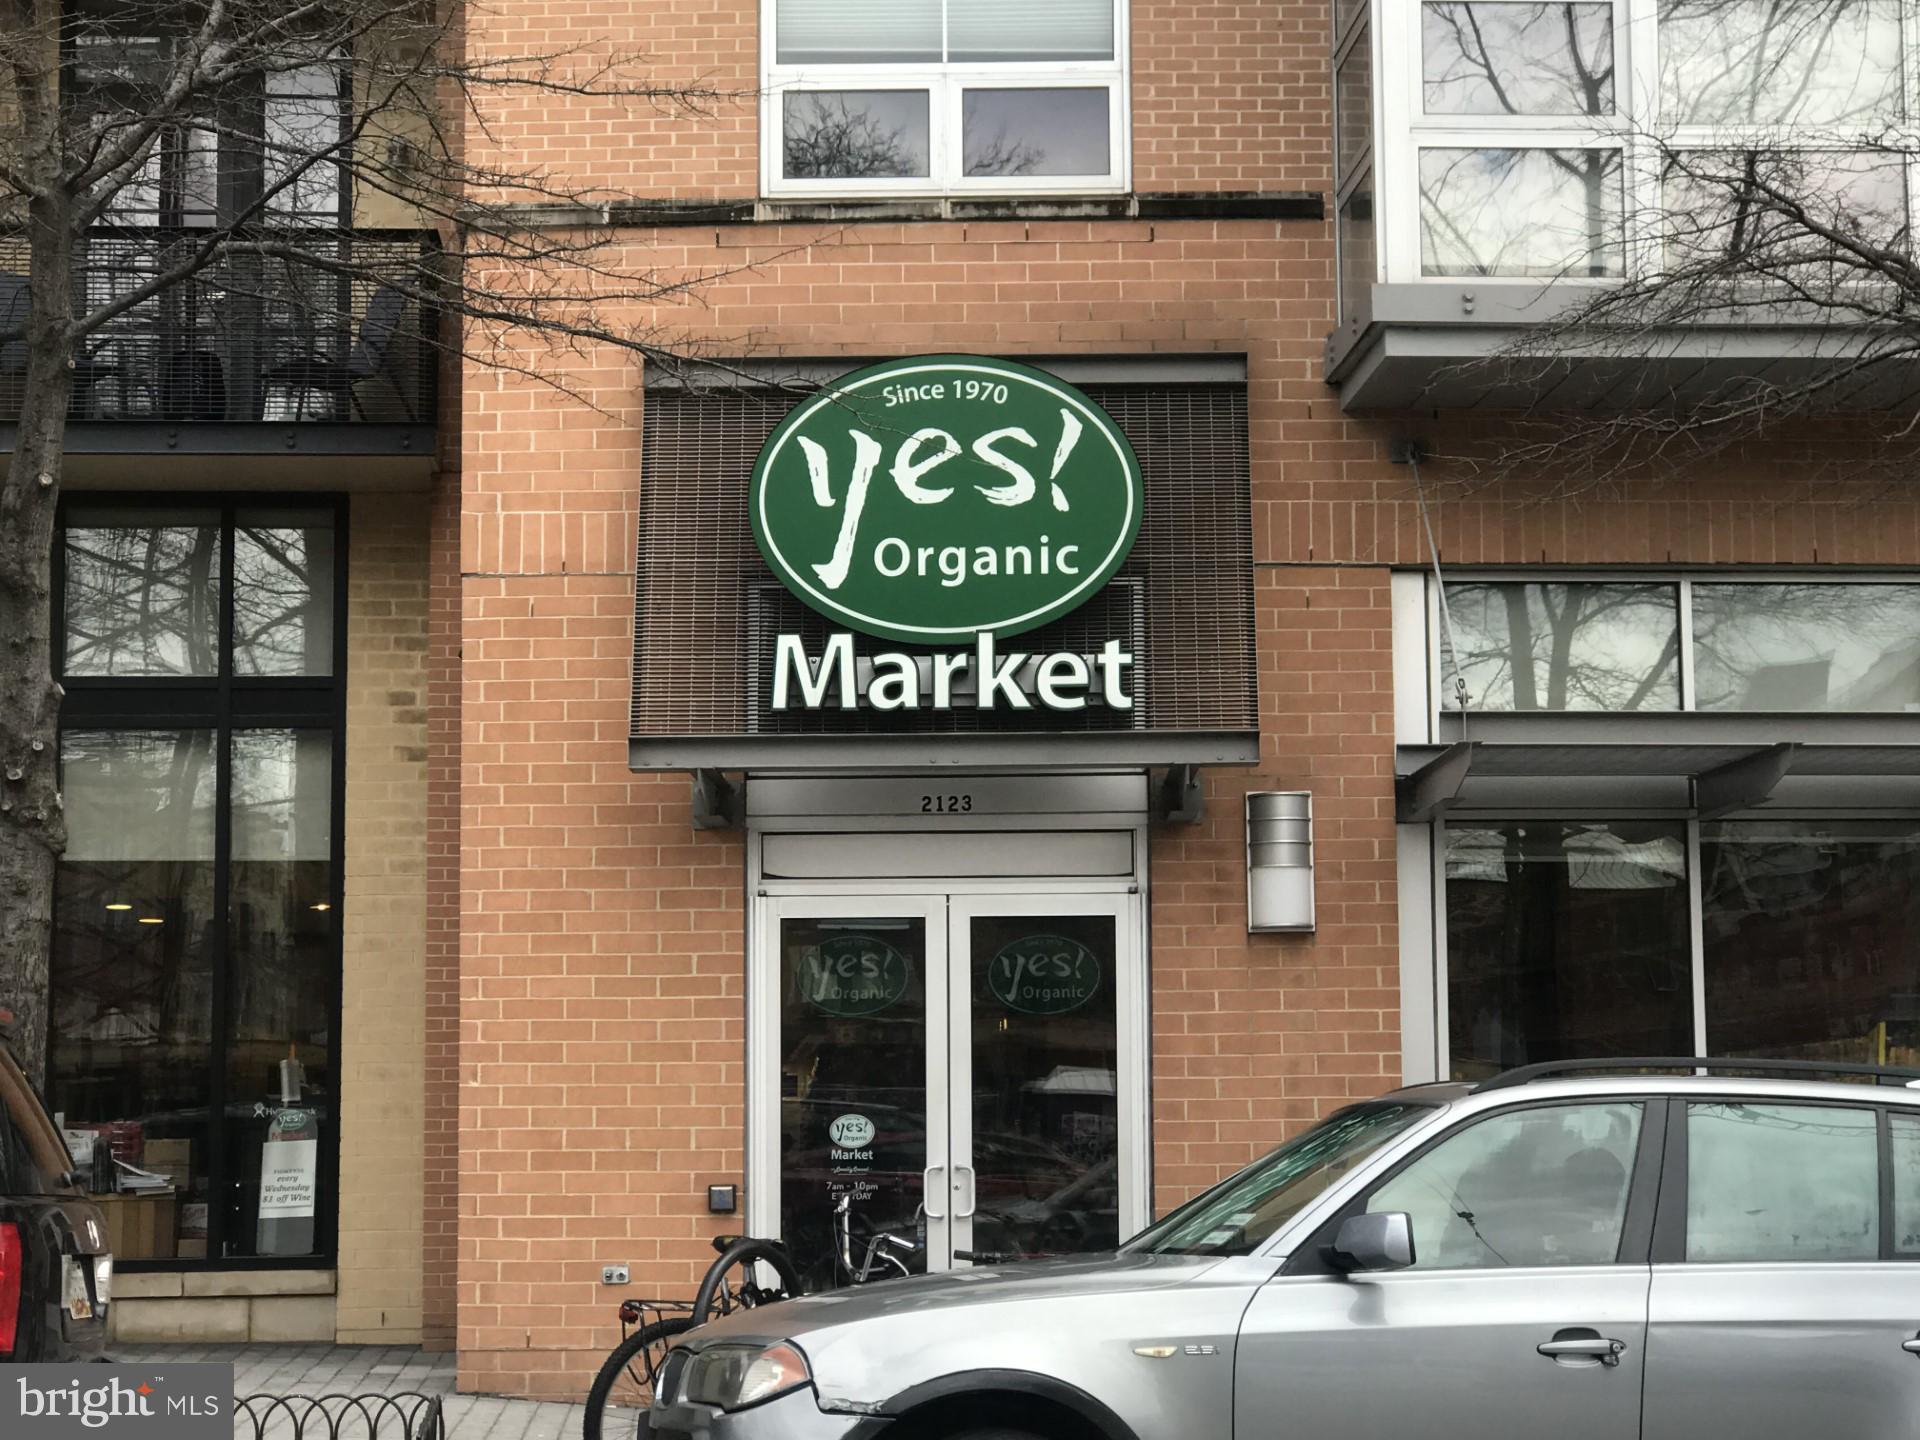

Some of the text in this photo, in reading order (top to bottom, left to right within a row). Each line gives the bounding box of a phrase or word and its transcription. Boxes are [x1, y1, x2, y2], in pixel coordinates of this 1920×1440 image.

[882, 379, 1009, 407] Since 1970
[874, 535, 1079, 587] Organic
[772, 630, 1134, 711] Market
[921, 795, 973, 812] 2123
[831, 985, 893, 1002] Organic
[1022, 985, 1085, 1002] Organic
[831, 1149, 874, 1160] Market
[264, 1184, 310, 1193] Wednesday
[826, 1181, 844, 1190] 7am
[854, 1181, 879, 1191] 10pm
[276, 1194, 290, 1203] off
